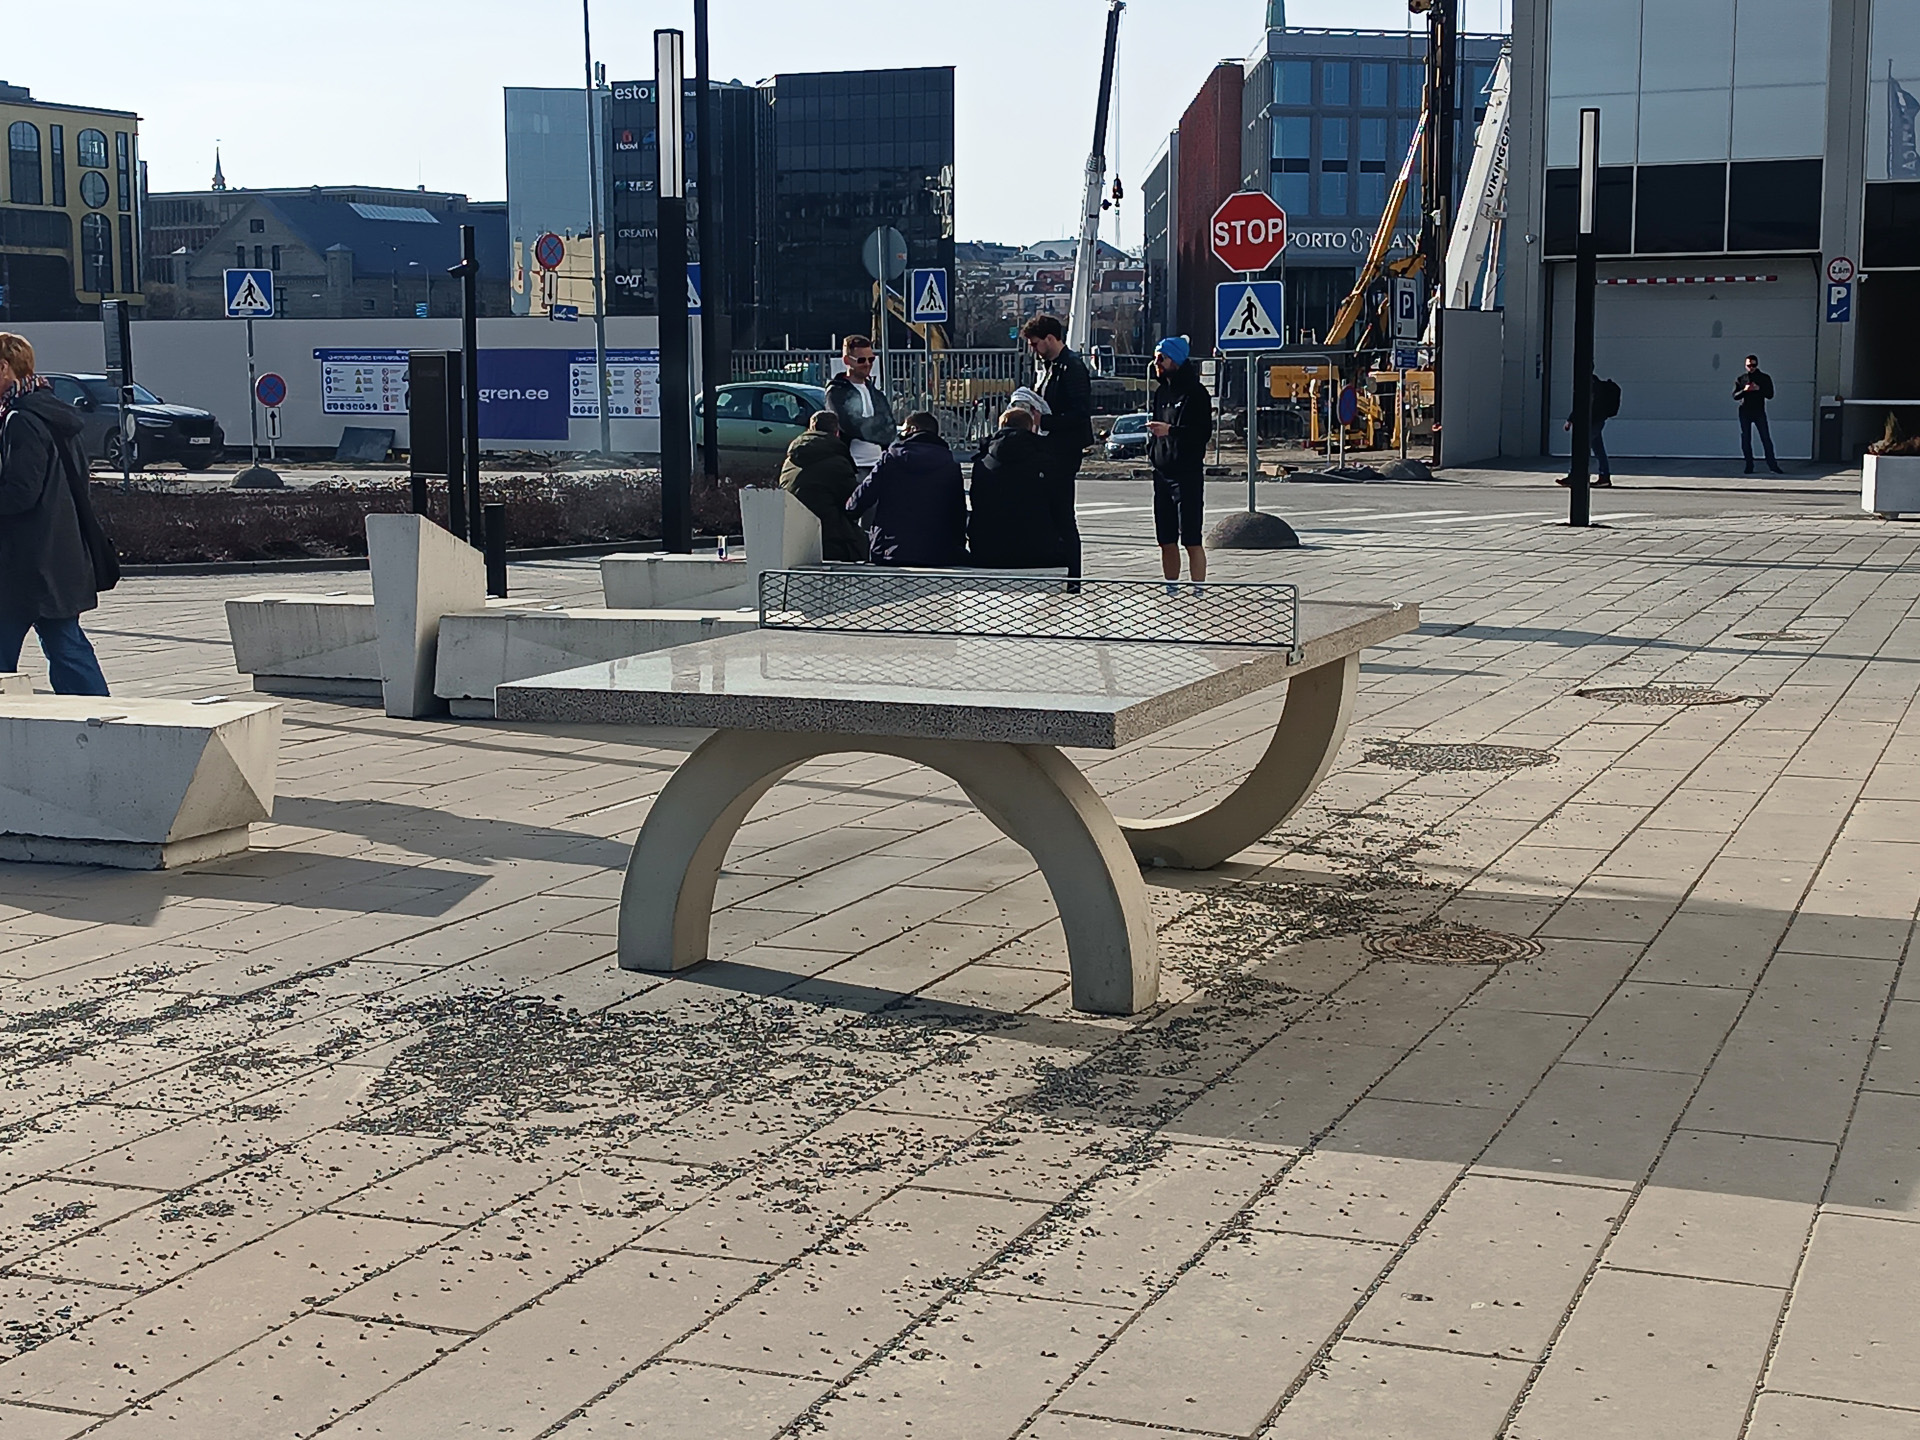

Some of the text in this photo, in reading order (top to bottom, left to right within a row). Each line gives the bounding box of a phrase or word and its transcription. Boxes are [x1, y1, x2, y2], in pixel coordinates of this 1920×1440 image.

[614, 84, 649, 100] esto
[1215, 217, 1283, 248] STOP
[1402, 293, 1412, 317] P
[1830, 286, 1848, 305] P
[478, 388, 549, 403] gren.ee
